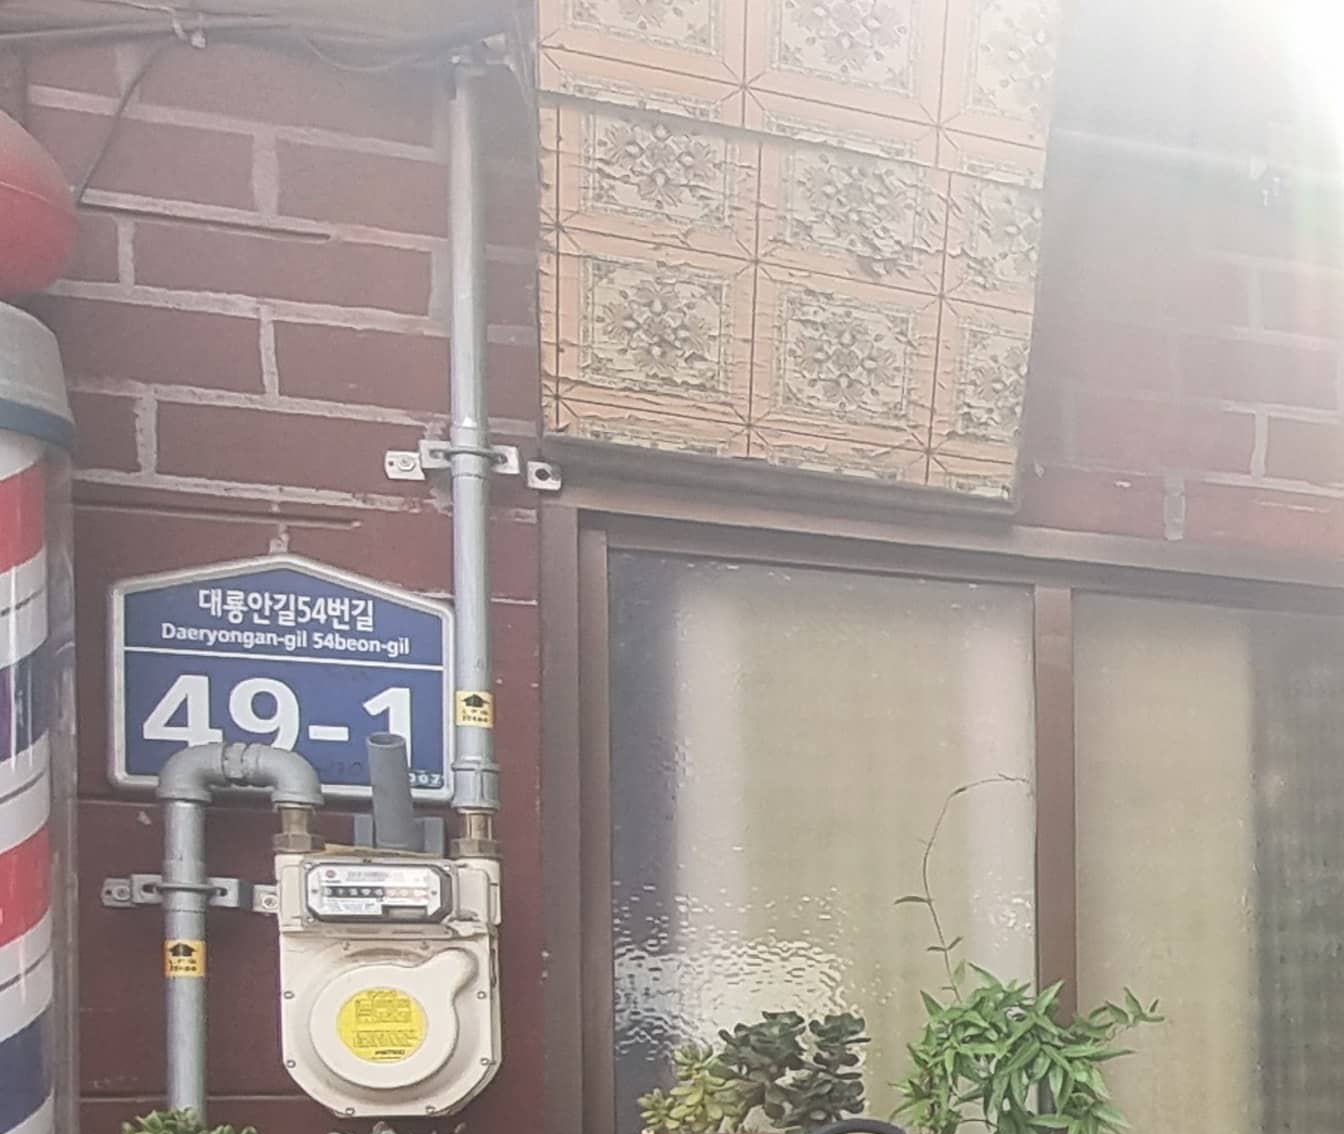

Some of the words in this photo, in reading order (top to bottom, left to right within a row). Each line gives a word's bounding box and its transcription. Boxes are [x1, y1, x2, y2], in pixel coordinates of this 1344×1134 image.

[198, 588, 375, 632] 대룡안길54번길
[161, 622, 307, 651] Daeryongan-gil
[313, 634, 410, 658] 54beon-gil
[142, 673, 413, 778] 49-1
